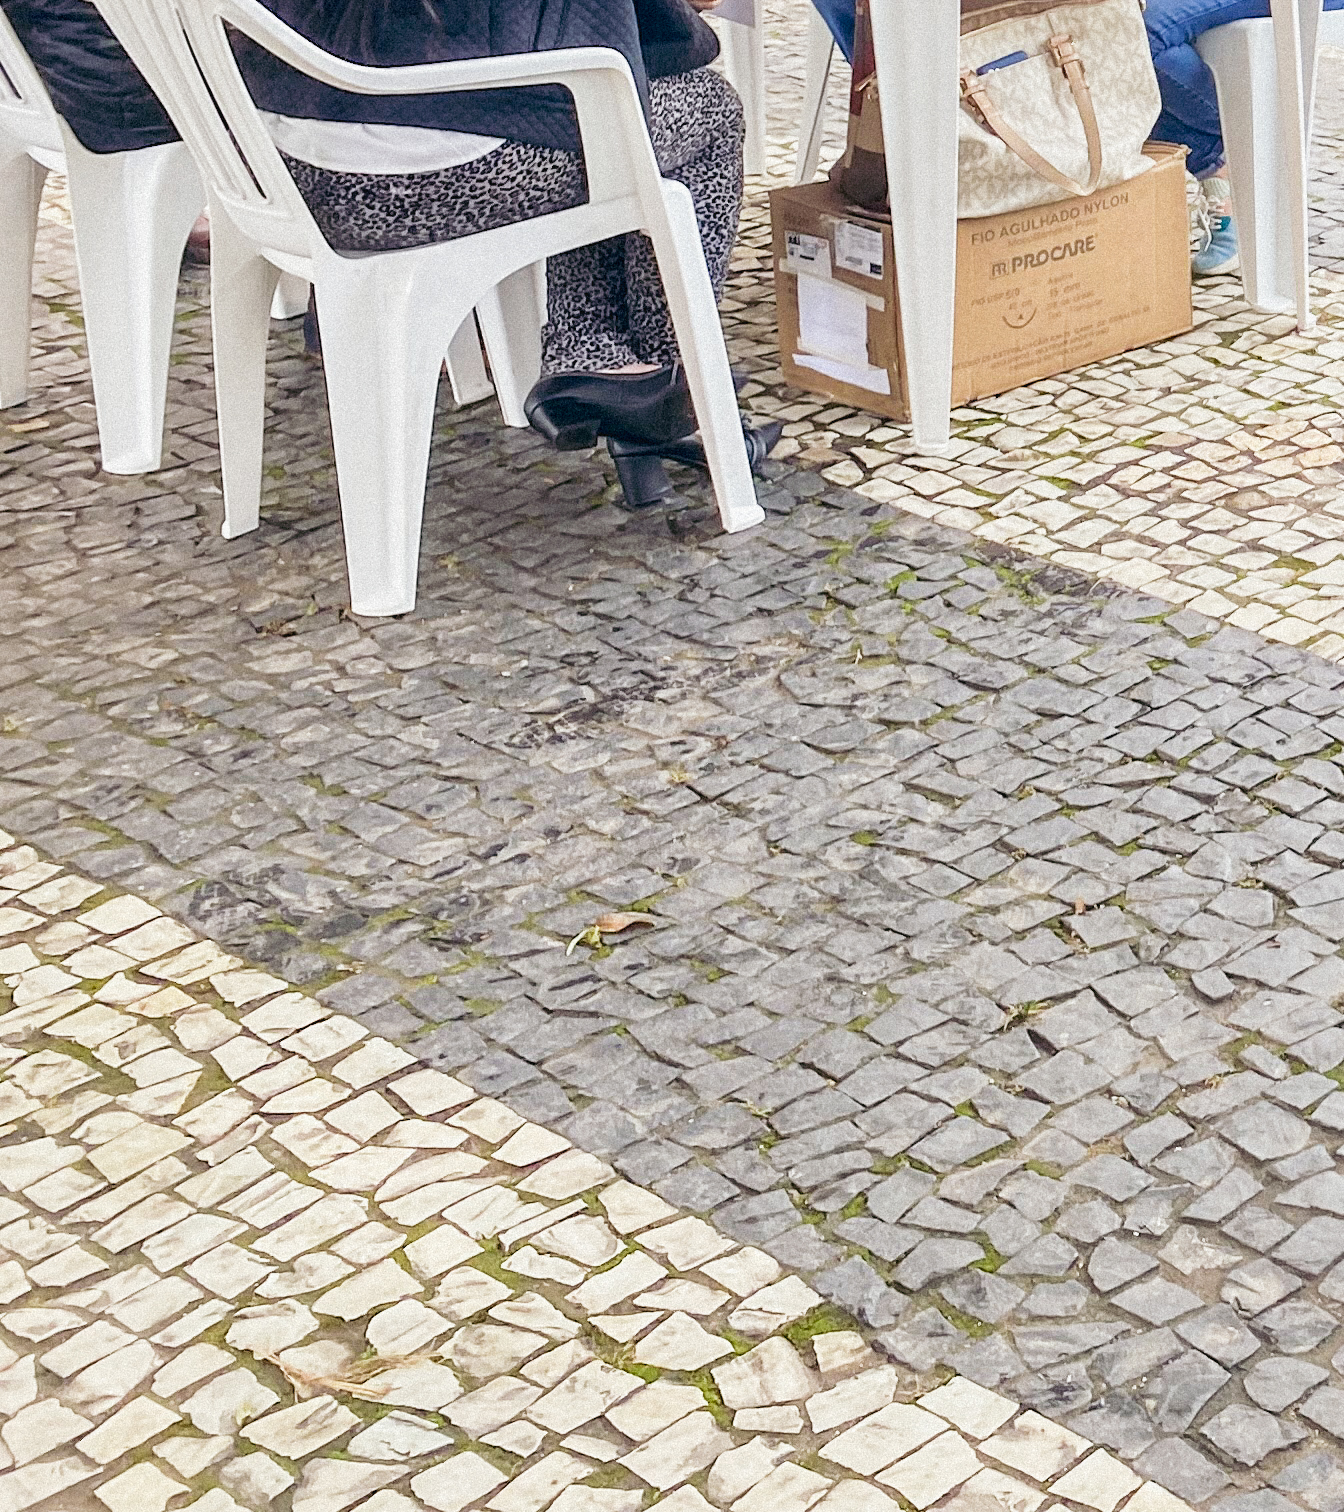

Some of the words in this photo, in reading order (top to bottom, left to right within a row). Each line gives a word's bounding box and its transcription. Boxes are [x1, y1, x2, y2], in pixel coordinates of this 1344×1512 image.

[970, 229, 996, 246] FIO
[999, 206, 1081, 240] AGULHADO
[1083, 191, 1130, 215] NYLON
[1012, 234, 1096, 274] PROCARE
